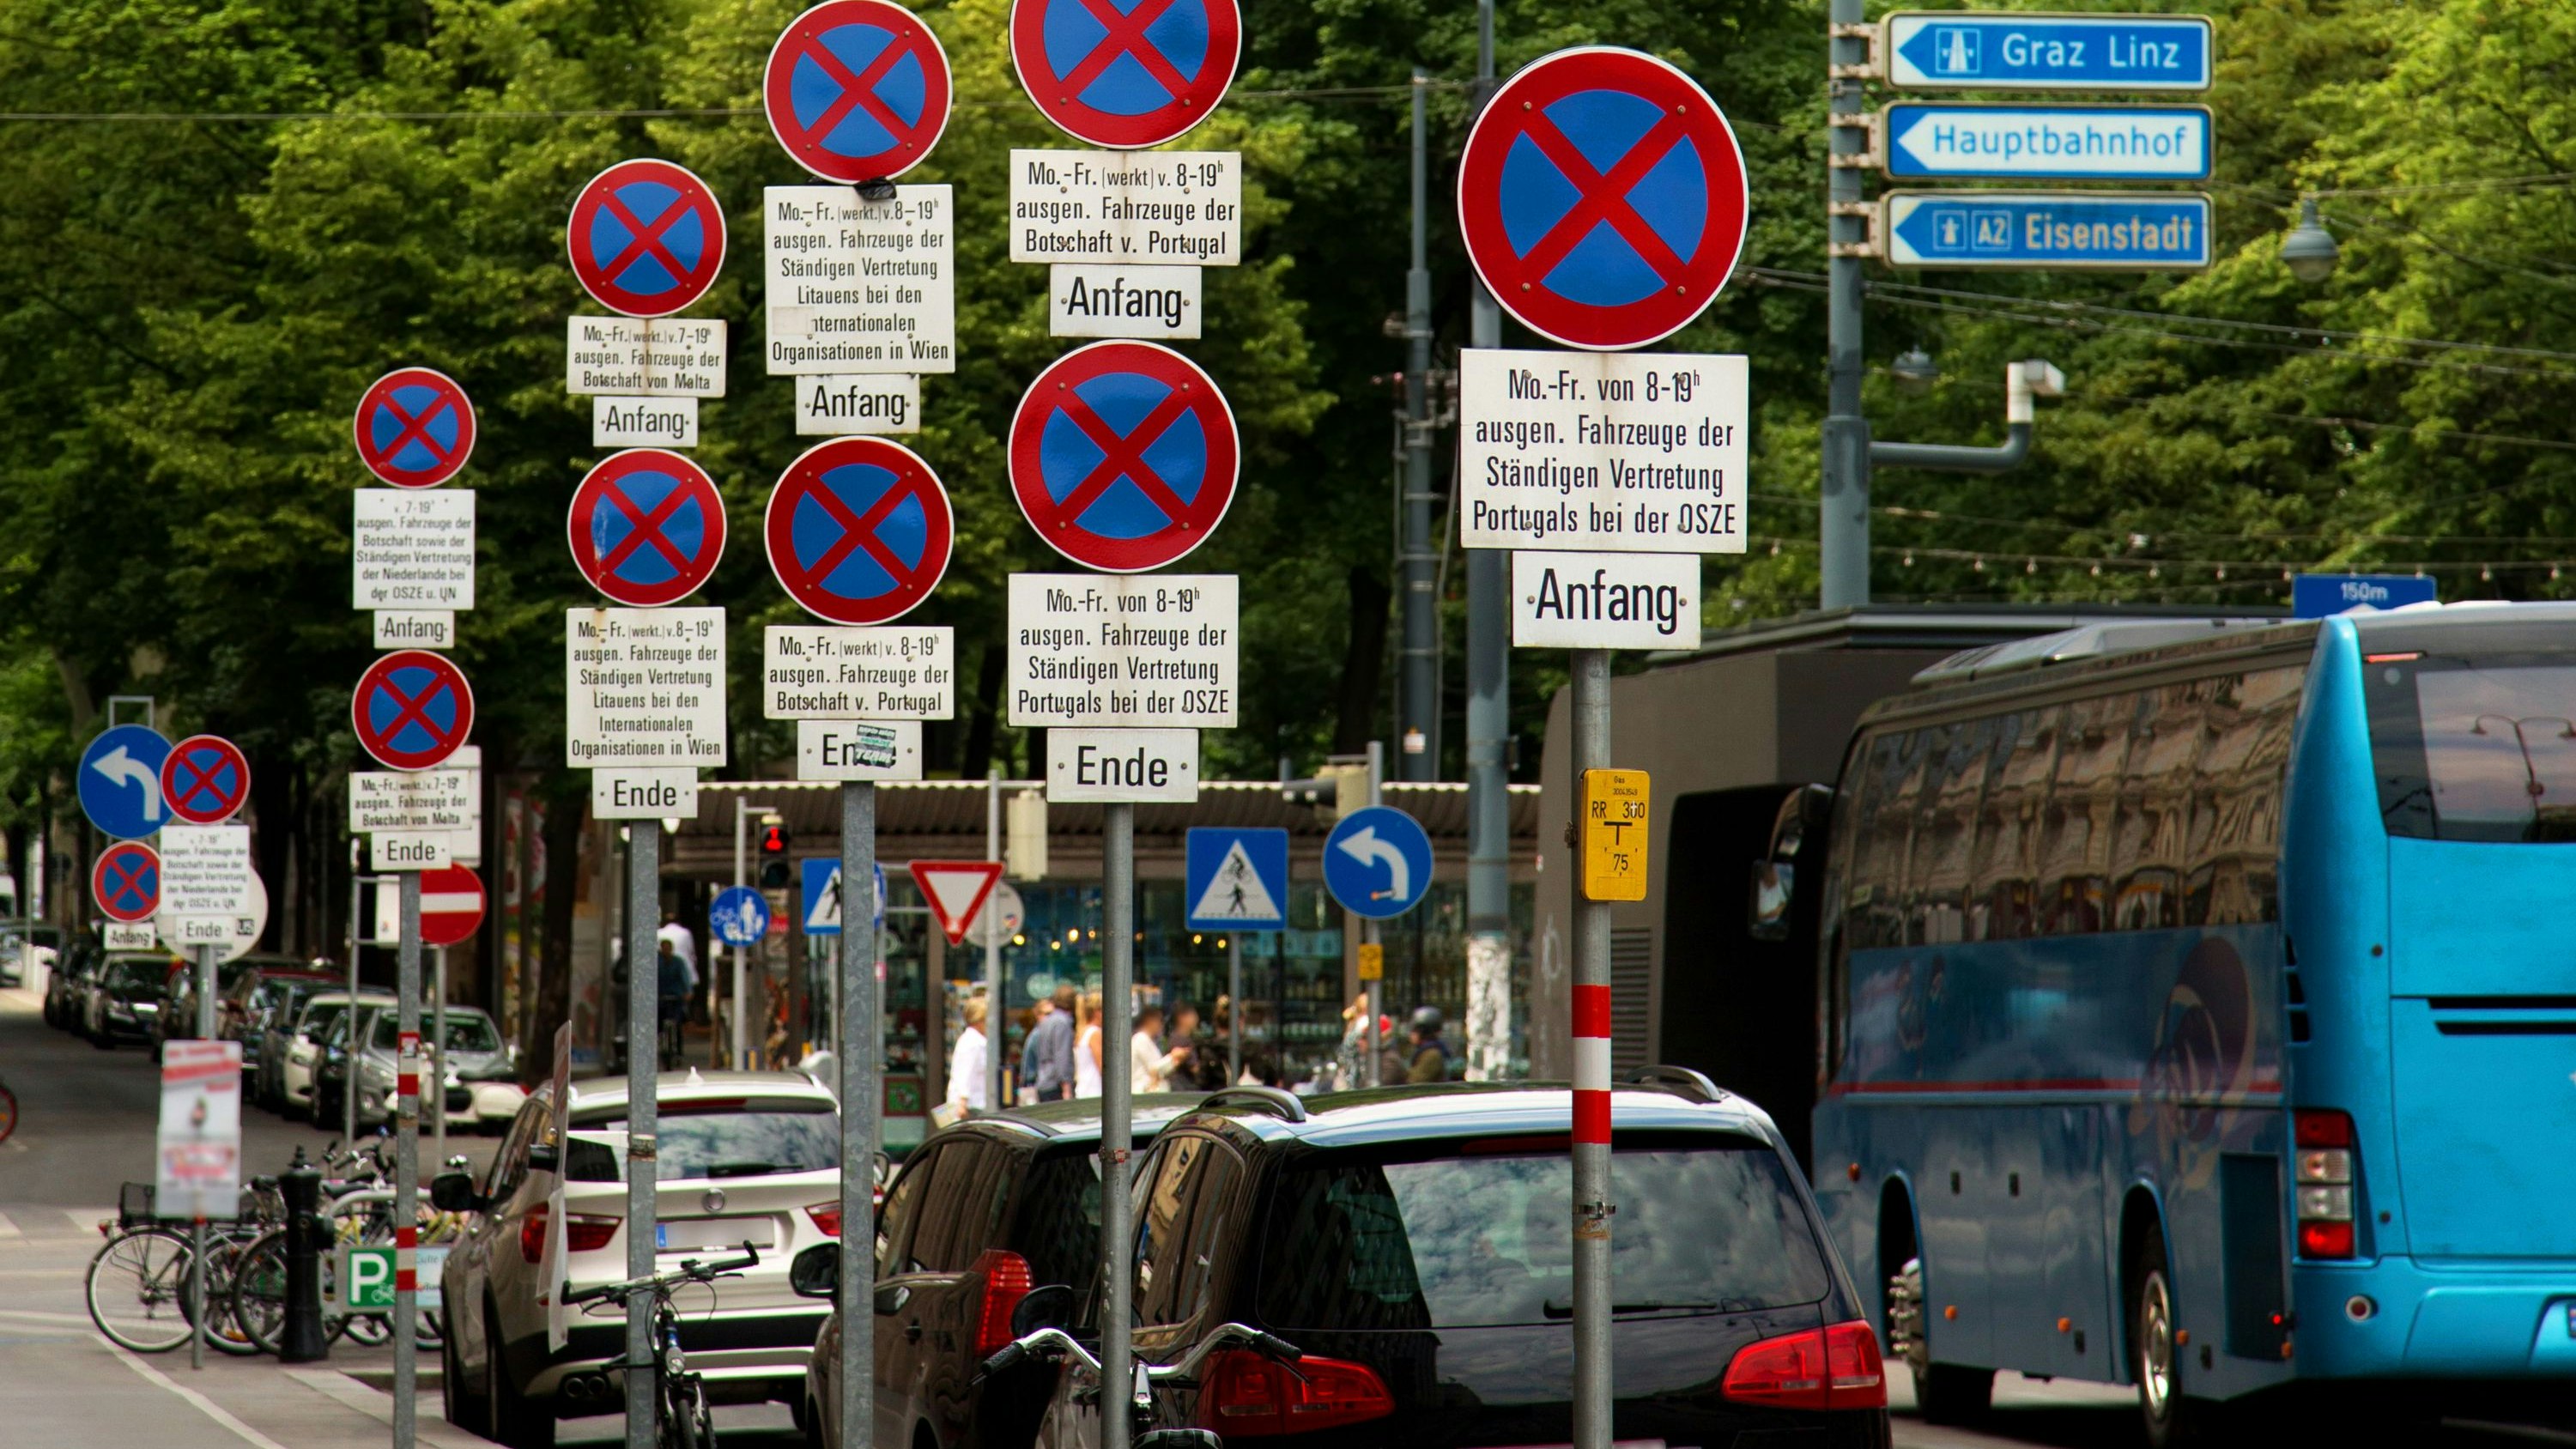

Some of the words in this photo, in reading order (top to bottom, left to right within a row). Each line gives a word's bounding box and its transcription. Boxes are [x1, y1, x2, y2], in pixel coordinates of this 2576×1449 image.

[2003, 33, 2085, 66] Graz
[2110, 35, 2179, 68] Linz
[1934, 124, 2186, 160] Hauptbahnhof
[1017, 201, 1090, 223] ausgen.
[1103, 197, 1195, 225] Fahrzeuge
[1205, 198, 1234, 221] der
[774, 233, 832, 252] ausgen.
[840, 230, 913, 252] Fahrzeuge
[920, 230, 943, 247] der
[1978, 217, 2006, 245] A2
[2026, 214, 2192, 250] Eisenstadt
[1026, 229, 1112, 252] Botschaft
[1149, 231, 1225, 259] Portugal
[781, 258, 855, 281] Ständigen
[862, 258, 937, 281] Vertretung
[798, 285, 858, 304] Litauens
[866, 285, 888, 304] bei
[895, 286, 922, 304] den
[1068, 276, 1182, 328] Anfang
[811, 313, 915, 332] nternationalen
[575, 352, 625, 367] ausgen.
[632, 350, 694, 369] Fahrzeuge
[700, 352, 719, 367] der
[773, 342, 882, 365] Organisationen
[890, 342, 903, 360] in
[909, 342, 949, 361] Wien
[584, 370, 641, 389] Botschaft
[647, 376, 667, 389] von
[675, 373, 710, 390] Malta
[1597, 379, 1633, 401] von
[812, 385, 906, 426] Anfang
[606, 405, 684, 439] Anfang
[1476, 421, 1564, 450] ausgen.
[1579, 415, 1686, 452] Fahrzeuge
[1699, 417, 1733, 446] der
[1487, 456, 1598, 494] Ständigen
[1609, 458, 1723, 497] Vertretung
[357, 519, 395, 530] ausgen.
[400, 517, 452, 530] Fahrzeuge
[456, 517, 470, 528] der
[1474, 500, 1577, 538] Portugals
[1591, 502, 1622, 533] bei
[1634, 503, 1669, 533] der
[1679, 504, 1735, 534] OSZE
[363, 535, 412, 547] Botschaft
[416, 536, 445, 547] sowie
[450, 536, 464, 547] der
[356, 551, 410, 565] Ständigen
[414, 552, 471, 566] Vertretung
[362, 568, 379, 579] der
[383, 569, 445, 579] Niederlande
[450, 569, 464, 579] bei
[371, 587, 387, 599] der
[393, 587, 422, 599] OSZE
[1536, 568, 1677, 634] Anfang
[2341, 582, 2388, 602] 150m
[1118, 595, 1146, 612] von
[384, 616, 444, 642] Anfang
[1021, 628, 1090, 652] ausgen.
[1102, 623, 1189, 652] Fahrzeuge
[1198, 623, 1227, 646] der
[574, 648, 623, 664] ausgen.
[630, 646, 692, 664] Fahrzeuge
[698, 646, 718, 662] der
[580, 669, 642, 688] Ständigen
[648, 669, 712, 688] Vertretung
[770, 667, 831, 687] ausgen.
[924, 666, 949, 684] der
[1029, 656, 1117, 684] Ständigen
[1127, 657, 1219, 684] Vertretung
[594, 692, 645, 708] Litauens
[652, 692, 671, 708] bei
[676, 692, 699, 708] den
[778, 691, 849, 711] Botschaft
[878, 692, 942, 714] Portugal
[1019, 690, 1101, 718] Portugals
[1112, 690, 1136, 712] bei
[1147, 690, 1174, 712] der
[1183, 690, 1228, 713] OSZE
[600, 716, 693, 733] Internationalen
[572, 739, 664, 759] Organisationen
[670, 740, 682, 756] in
[688, 740, 720, 756] Wien
[822, 733, 895, 767] En
[1077, 745, 1167, 787] Ende
[1614, 775, 1625, 784] Gas
[355, 800, 393, 810] ausgen.
[398, 796, 446, 809] Fahrzeuge
[452, 796, 466, 806] der
[614, 779, 676, 807] Ende
[363, 814, 408, 826] Botschaft
[433, 812, 460, 824] Malta
[1592, 801, 1606, 818] RR
[388, 840, 435, 861] Ende
[1614, 854, 1628, 870] 75
[111, 930, 149, 946] Anfang
[187, 921, 221, 937] Ende
[352, 1253, 389, 1303] P
